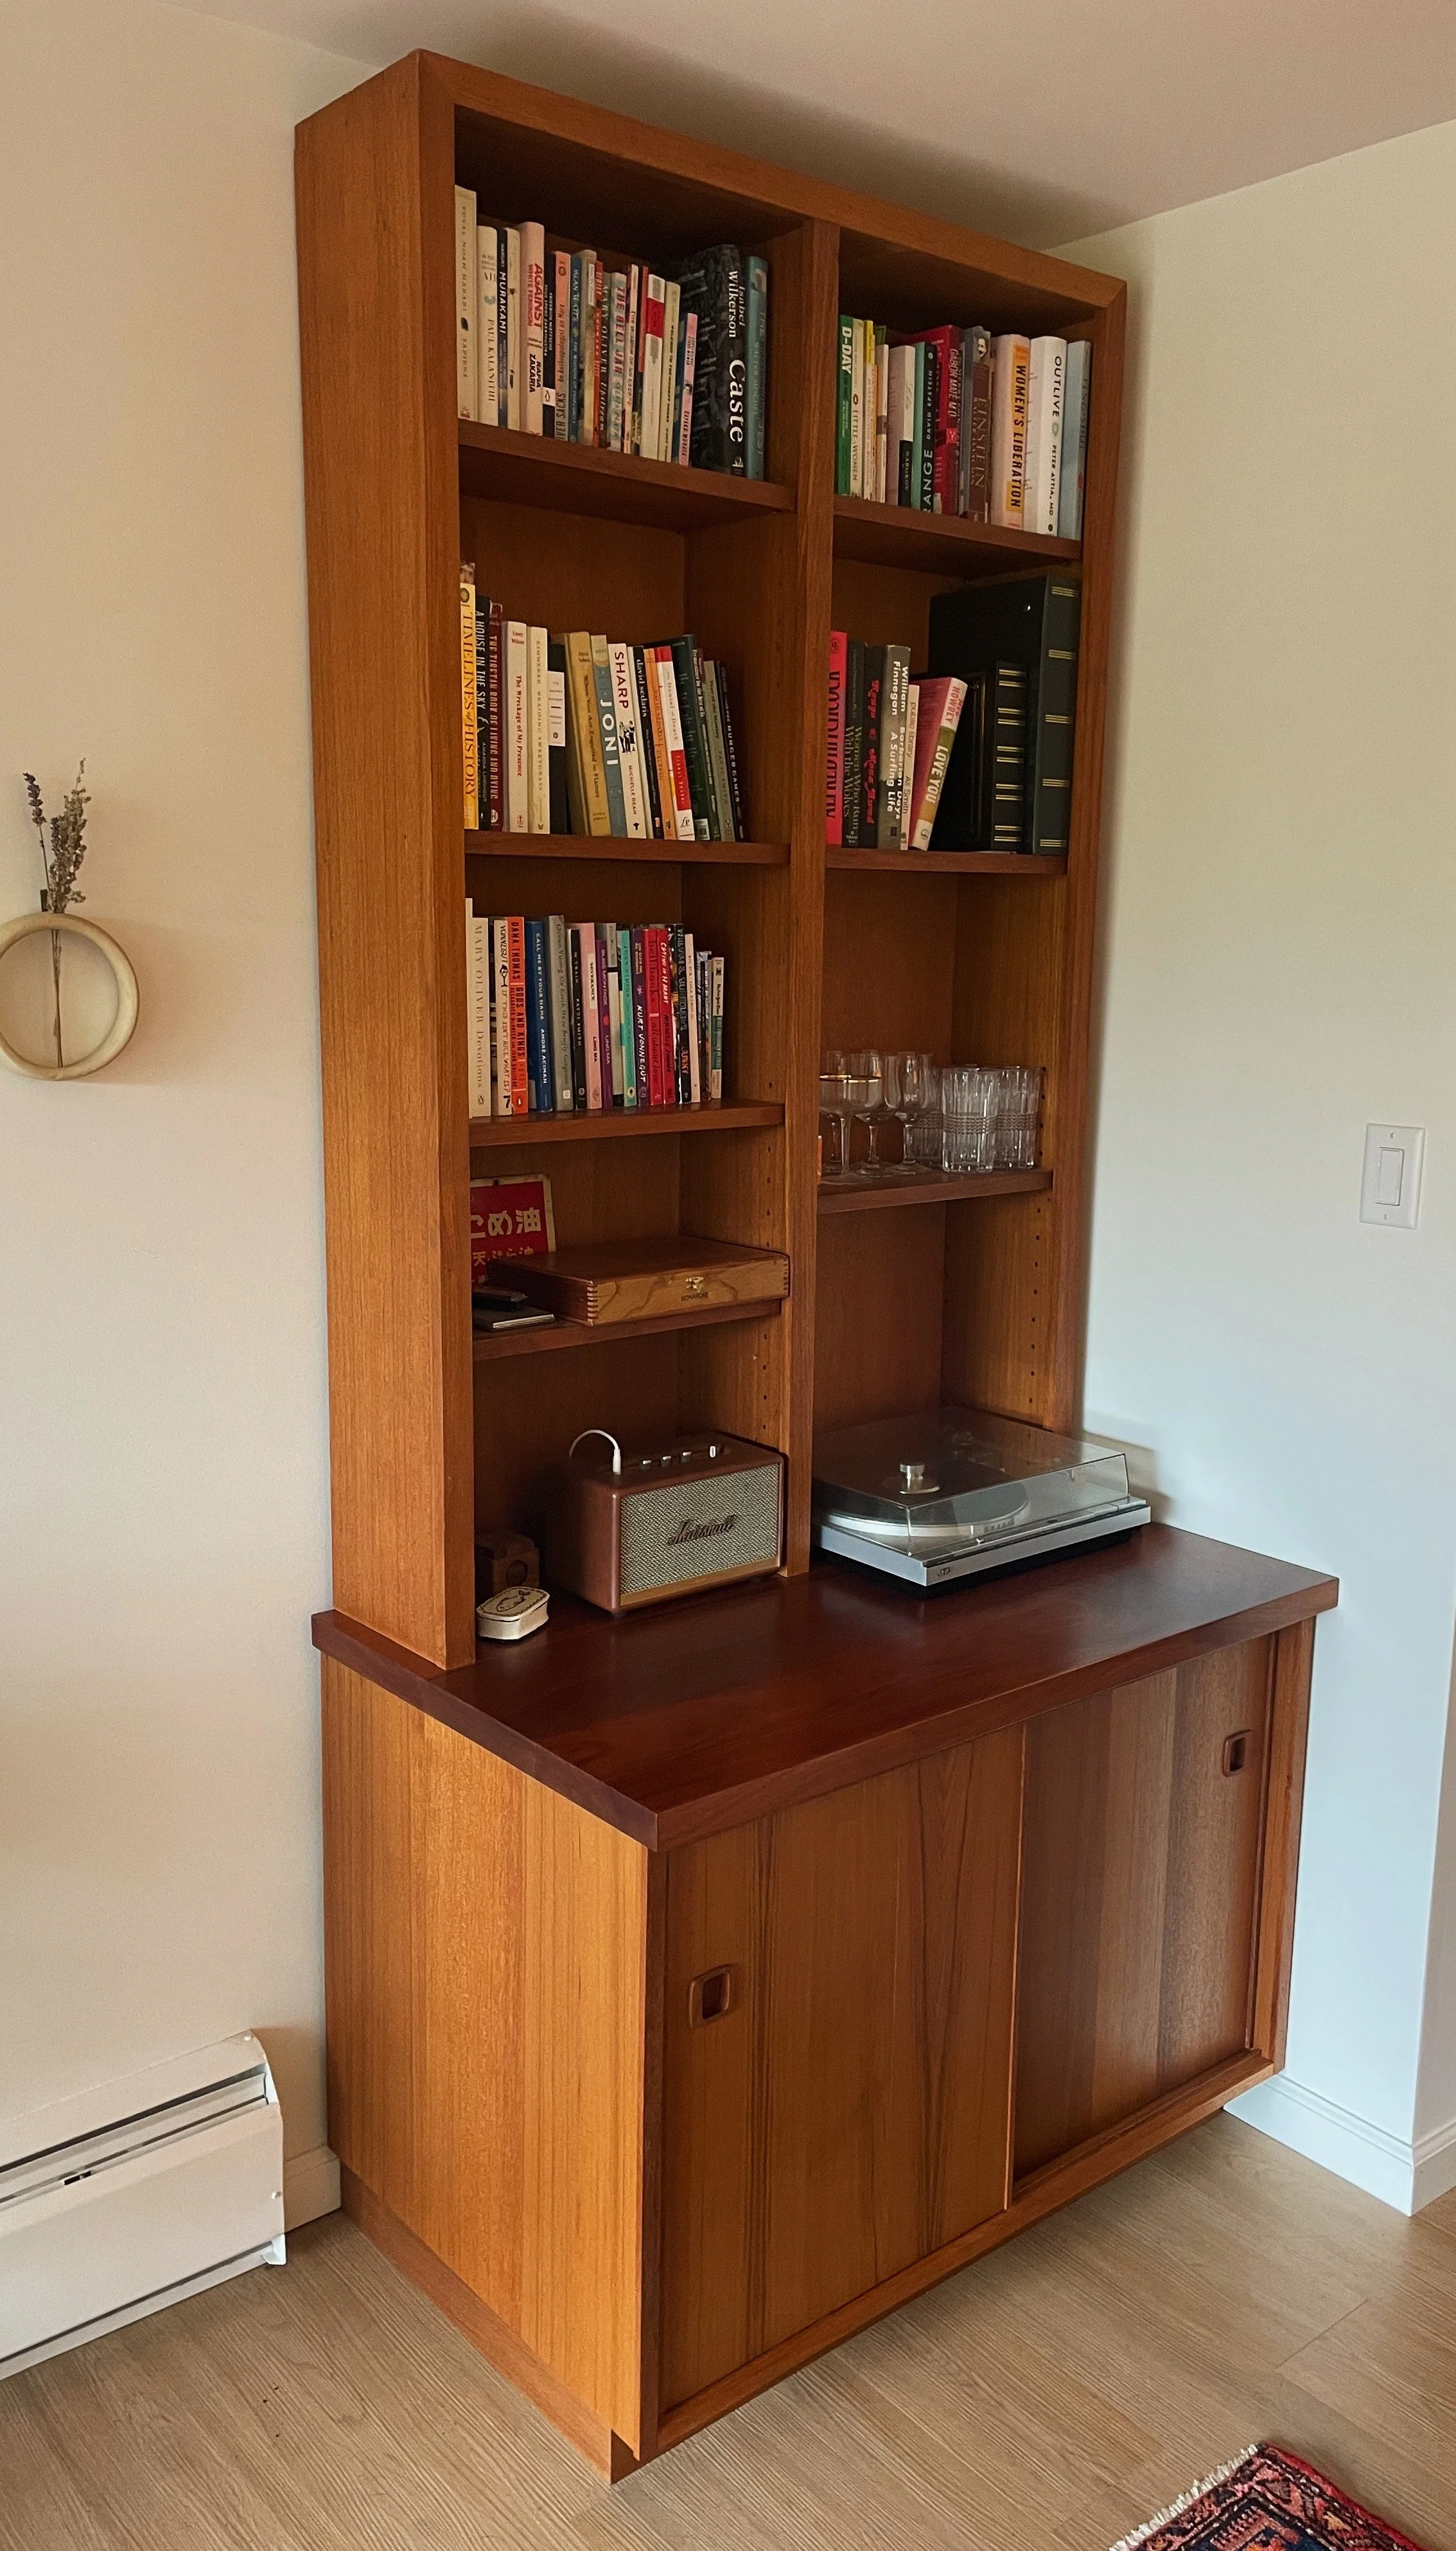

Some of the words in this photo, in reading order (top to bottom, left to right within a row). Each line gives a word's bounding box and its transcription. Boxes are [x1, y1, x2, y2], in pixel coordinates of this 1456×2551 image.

[534, 263, 543, 328] AGAINST
[617, 287, 625, 309] THE
[728, 270, 739, 338] Wilkerson
[616, 315, 624, 344] BELL
[615, 349, 624, 374] JAR
[842, 326, 852, 375] D-DAY
[949, 348, 958, 376] GABOR
[1013, 364, 1026, 427] WOMEN'S
[1053, 356, 1062, 417] OUTLIVE
[556, 393, 566, 418] SACKS
[729, 359, 745, 443] Caste
[975, 398, 987, 488] EINSTEIN
[1010, 432, 1024, 508] LIBERATION
[476, 621, 485, 651] HOUSE
[489, 635, 498, 651] THE
[463, 613, 475, 709] TIMELINES
[477, 657, 486, 666] IN
[489, 654, 498, 690] TIBETAN
[636, 659, 645, 684] david
[477, 671, 486, 687] THE
[615, 651, 629, 709] SHARP
[891, 660, 900, 715] Finnegan
[900, 666, 909, 712] William
[477, 691, 486, 709] SKY
[489, 691, 498, 712] BOOK
[639, 686, 648, 718] sedaris
[945, 686, 960, 725] HOWREY
[489, 715, 498, 725] OF
[908, 702, 917, 729] public
[489, 727, 499, 754] LIVING
[515, 734, 523, 743] My
[600, 698, 618, 766] JONI
[845, 725, 855, 755] With
[891, 732, 899, 741] A
[906, 730, 915, 758] library
[464, 723, 476, 799] HISTORY
[854, 726, 863, 771] Women
[897, 727, 906, 786] Barbarian
[932, 745, 949, 777] LOVE
[844, 757, 854, 775] the
[886, 743, 898, 787] Surfing
[843, 778, 854, 817] Wolves
[853, 774, 862, 802] Who
[887, 791, 896, 813] Life
[902, 789, 911, 815] Smith
[925, 778, 940, 804] YOU
[511, 922, 520, 944] DANA
[512, 948, 521, 980] THOMAS
[537, 954, 542, 964] ME
[537, 966, 543, 975] BY
[679, 966, 685, 975] S.
[516, 987, 524, 1008] GODS
[516, 1012, 525, 1028] AND
[516, 1032, 525, 1057] KINGS
[638, 1034, 647, 1082] VONNEGUT
[669, 1515, 737, 1545] Marshall
